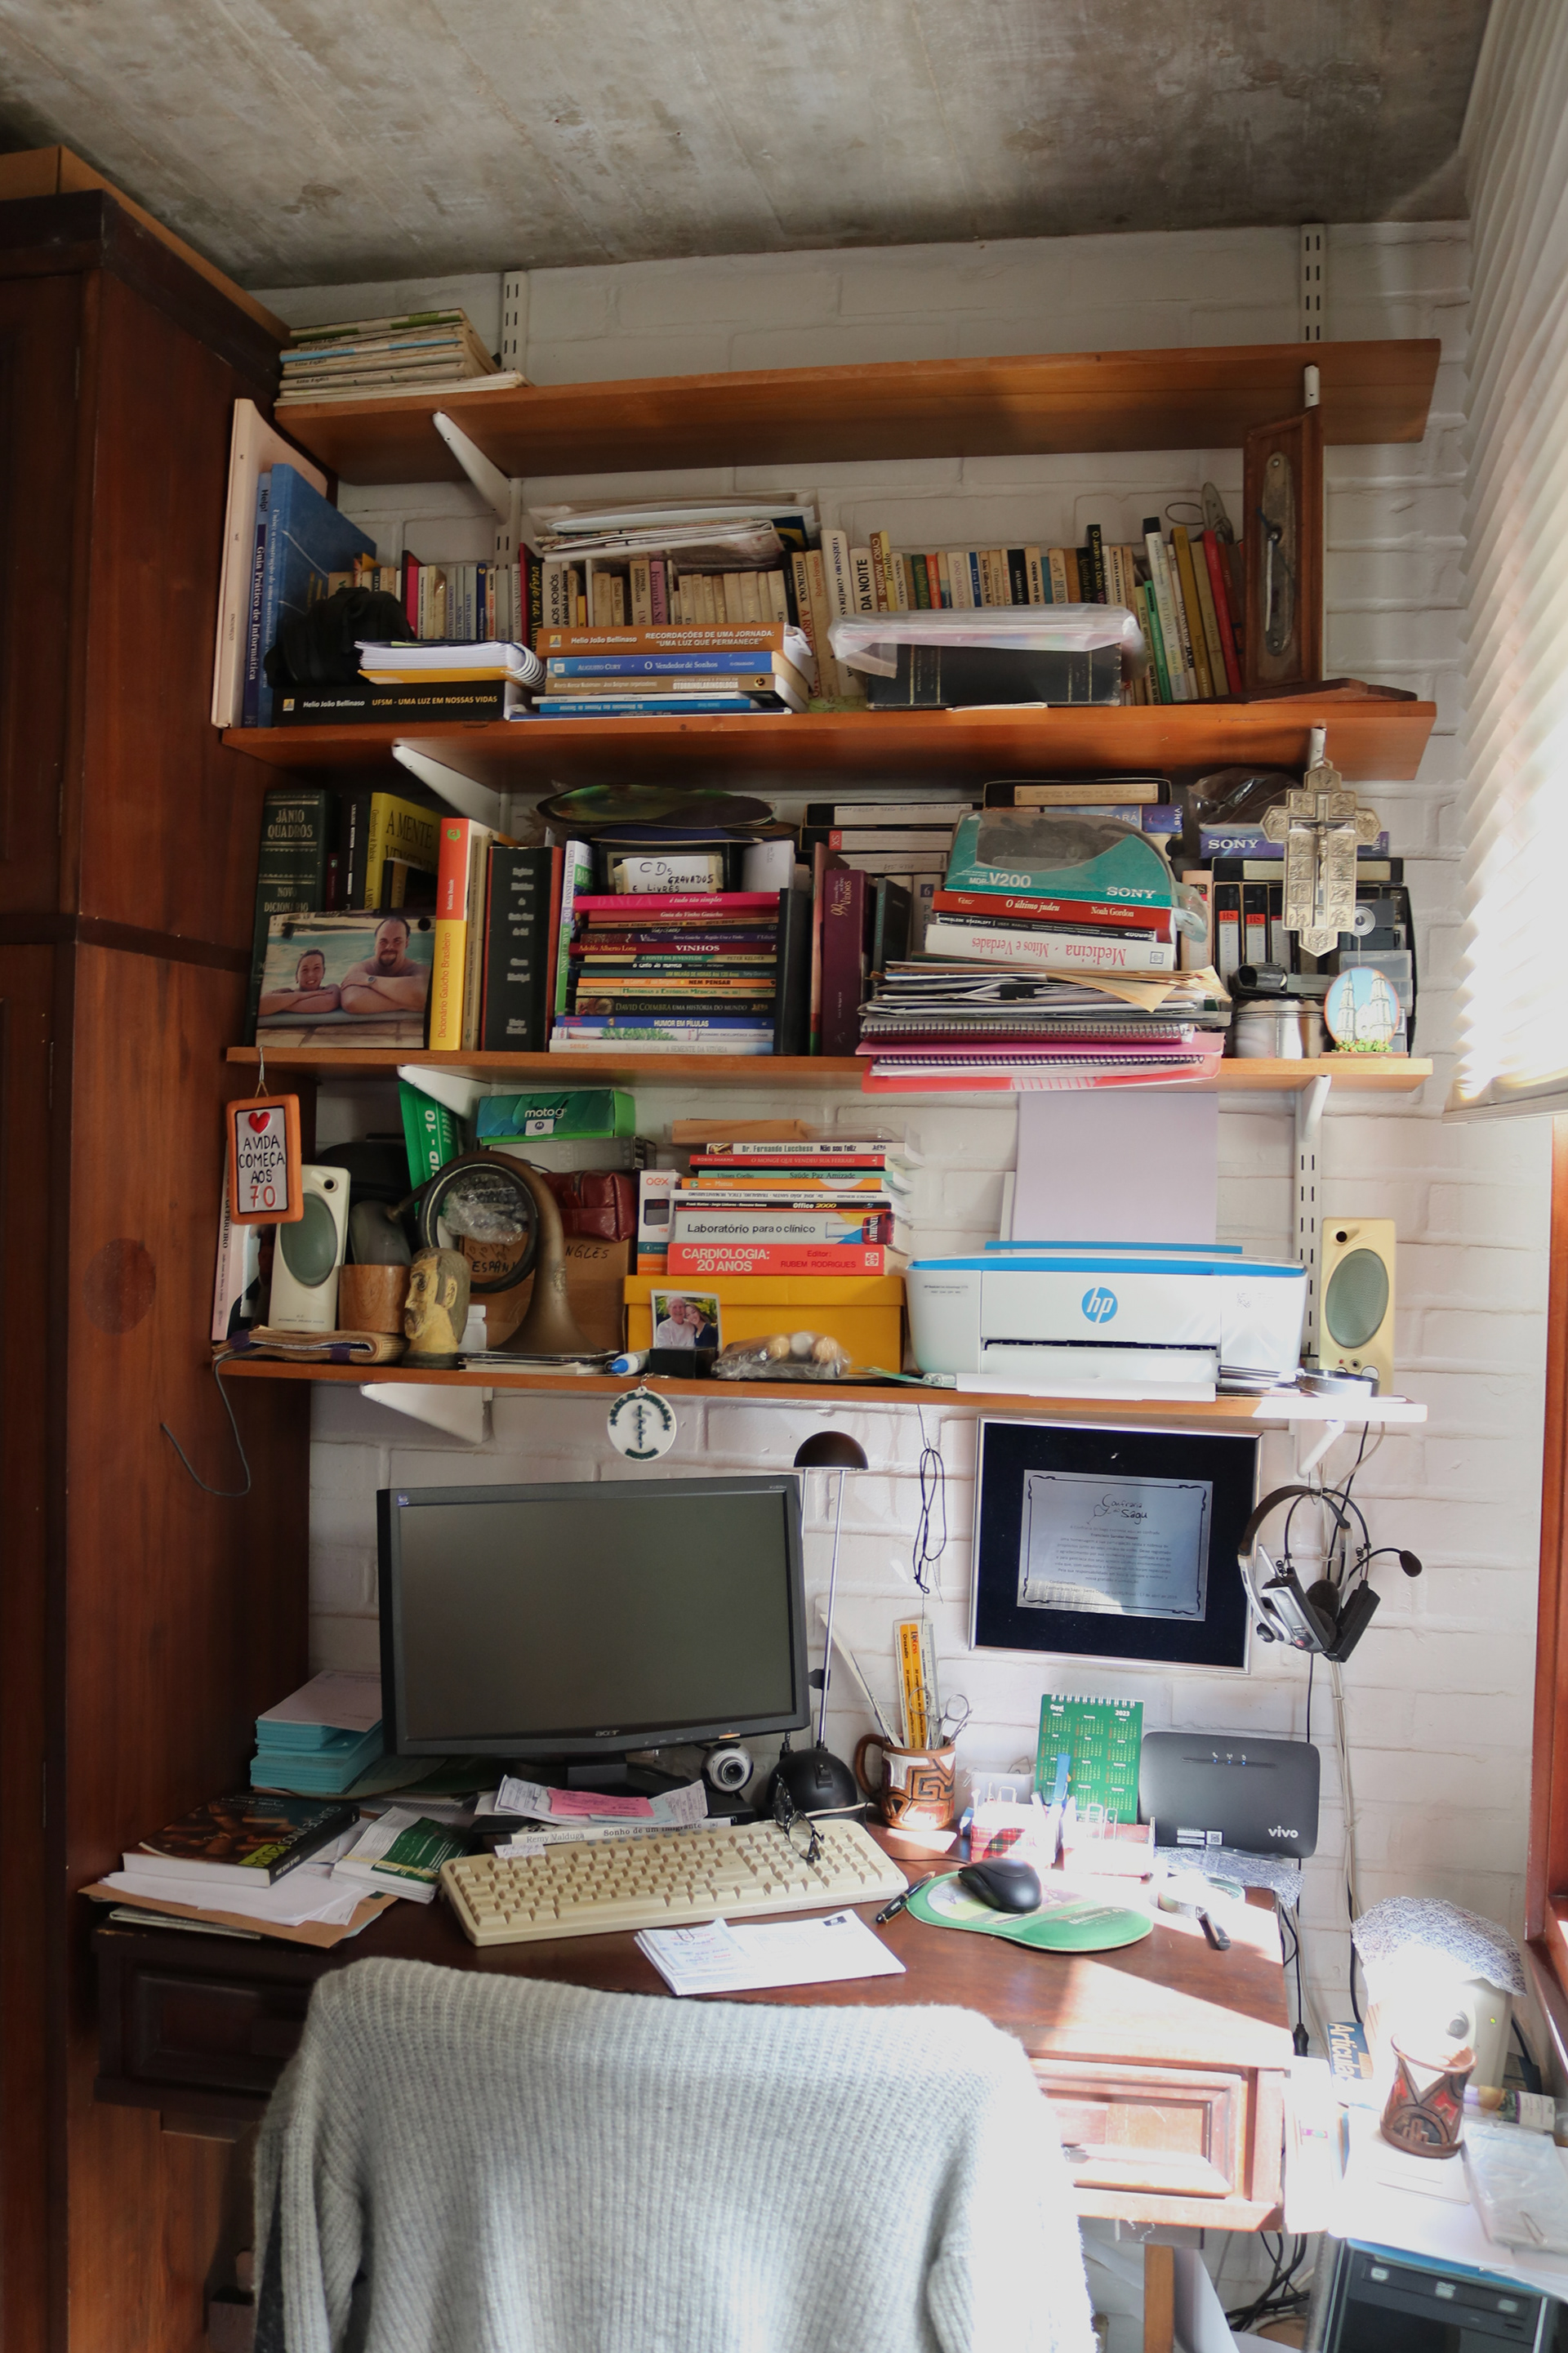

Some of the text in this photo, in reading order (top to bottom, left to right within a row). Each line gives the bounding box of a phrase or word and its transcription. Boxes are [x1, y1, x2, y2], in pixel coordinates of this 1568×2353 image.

[260, 489, 270, 512] Help!
[1093, 541, 1101, 561] Jardim
[871, 537, 886, 596] CYRO MARTINS
[883, 553, 893, 582] Ziraldo
[1094, 563, 1101, 572] do
[795, 560, 807, 603] HITCHCOCK
[857, 559, 872, 610] DA NOITE
[550, 574, 560, 625] AOS ROBÔS
[837, 577, 848, 615] COMÉDIAS
[248, 546, 264, 680] Guia Prático de Informática
[532, 600, 541, 618] na
[1160, 597, 1173, 635] FELIPÃO
[589, 636, 605, 644] João
[645, 631, 703, 640] RECORDAÇÕES
[644, 661, 653, 670] O
[655, 662, 684, 670] Vendedor
[320, 700, 336, 708] João
[372, 697, 393, 706] UFSM
[398, 697, 416, 706] UMA
[417, 697, 430, 705] LUZ
[445, 696, 474, 704] NOSSAS
[474, 695, 497, 703] VIDAS
[276, 808, 305, 823] JÂNIO
[268, 823, 313, 838] QUADROS
[386, 810, 433, 849] A MENTE
[1208, 839, 1259, 849] SONY
[667, 873, 715, 885] GRAVADOS
[922, 885, 931, 897] 6
[1107, 886, 1156, 898] SONY
[699, 895, 722, 904] simples
[830, 903, 849, 916] 99
[1005, 898, 1134, 918] O último judeu Noah Gordon
[559, 928, 569, 974] BARCELONA
[578, 944, 599, 952] Adolfo
[599, 944, 621, 952] Alberto
[971, 938, 1126, 965] Medicina Mitos e Verdades
[438, 933, 452, 1038] Dicionário Gaúcho Brasileiro
[615, 1002, 637, 1011] DAVID
[639, 1002, 671, 1011] COIMBRA
[686, 1003, 713, 1011] HISTÓRIA
[653, 1019, 675, 1027] HUMOR
[686, 1018, 709, 1027] PÍLULAS
[706, 1044, 728, 1053] VITÓRIA
[424, 1110, 437, 1133] 10
[243, 1134, 280, 1151] A VIDA
[742, 1144, 751, 1152] Dr.
[753, 1144, 782, 1152] Fernando
[783, 1144, 813, 1152] Lucchese
[819, 1143, 831, 1152] Não
[844, 1143, 857, 1152] feliz
[238, 1152, 286, 1169] COMEÇA
[251, 1169, 273, 1184] AOS
[645, 1177, 669, 1186] oex
[250, 1185, 276, 1208] 70
[221, 1199, 229, 1249] GUERREIRO
[687, 1223, 750, 1234] Laboratório
[752, 1225, 774, 1234] para
[783, 1223, 816, 1233] clínico
[869, 1215, 879, 1242] ATHENEU
[681, 1248, 831, 1260] CARDIOLOGIA: Editor:
[697, 1260, 857, 1272] 20 ANOS RUBEM RODRIGUES
[1085, 1287, 1114, 1323] hp
[1120, 1509, 1148, 1525] Sagu
[1115, 1709, 1130, 1717] 2023
[595, 1729, 620, 1737] acer
[526, 1832, 585, 1843] Remy Valduga
[603, 1828, 630, 1837] Sonho
[632, 1826, 643, 1834] de
[1267, 1825, 1298, 1838] vivo
